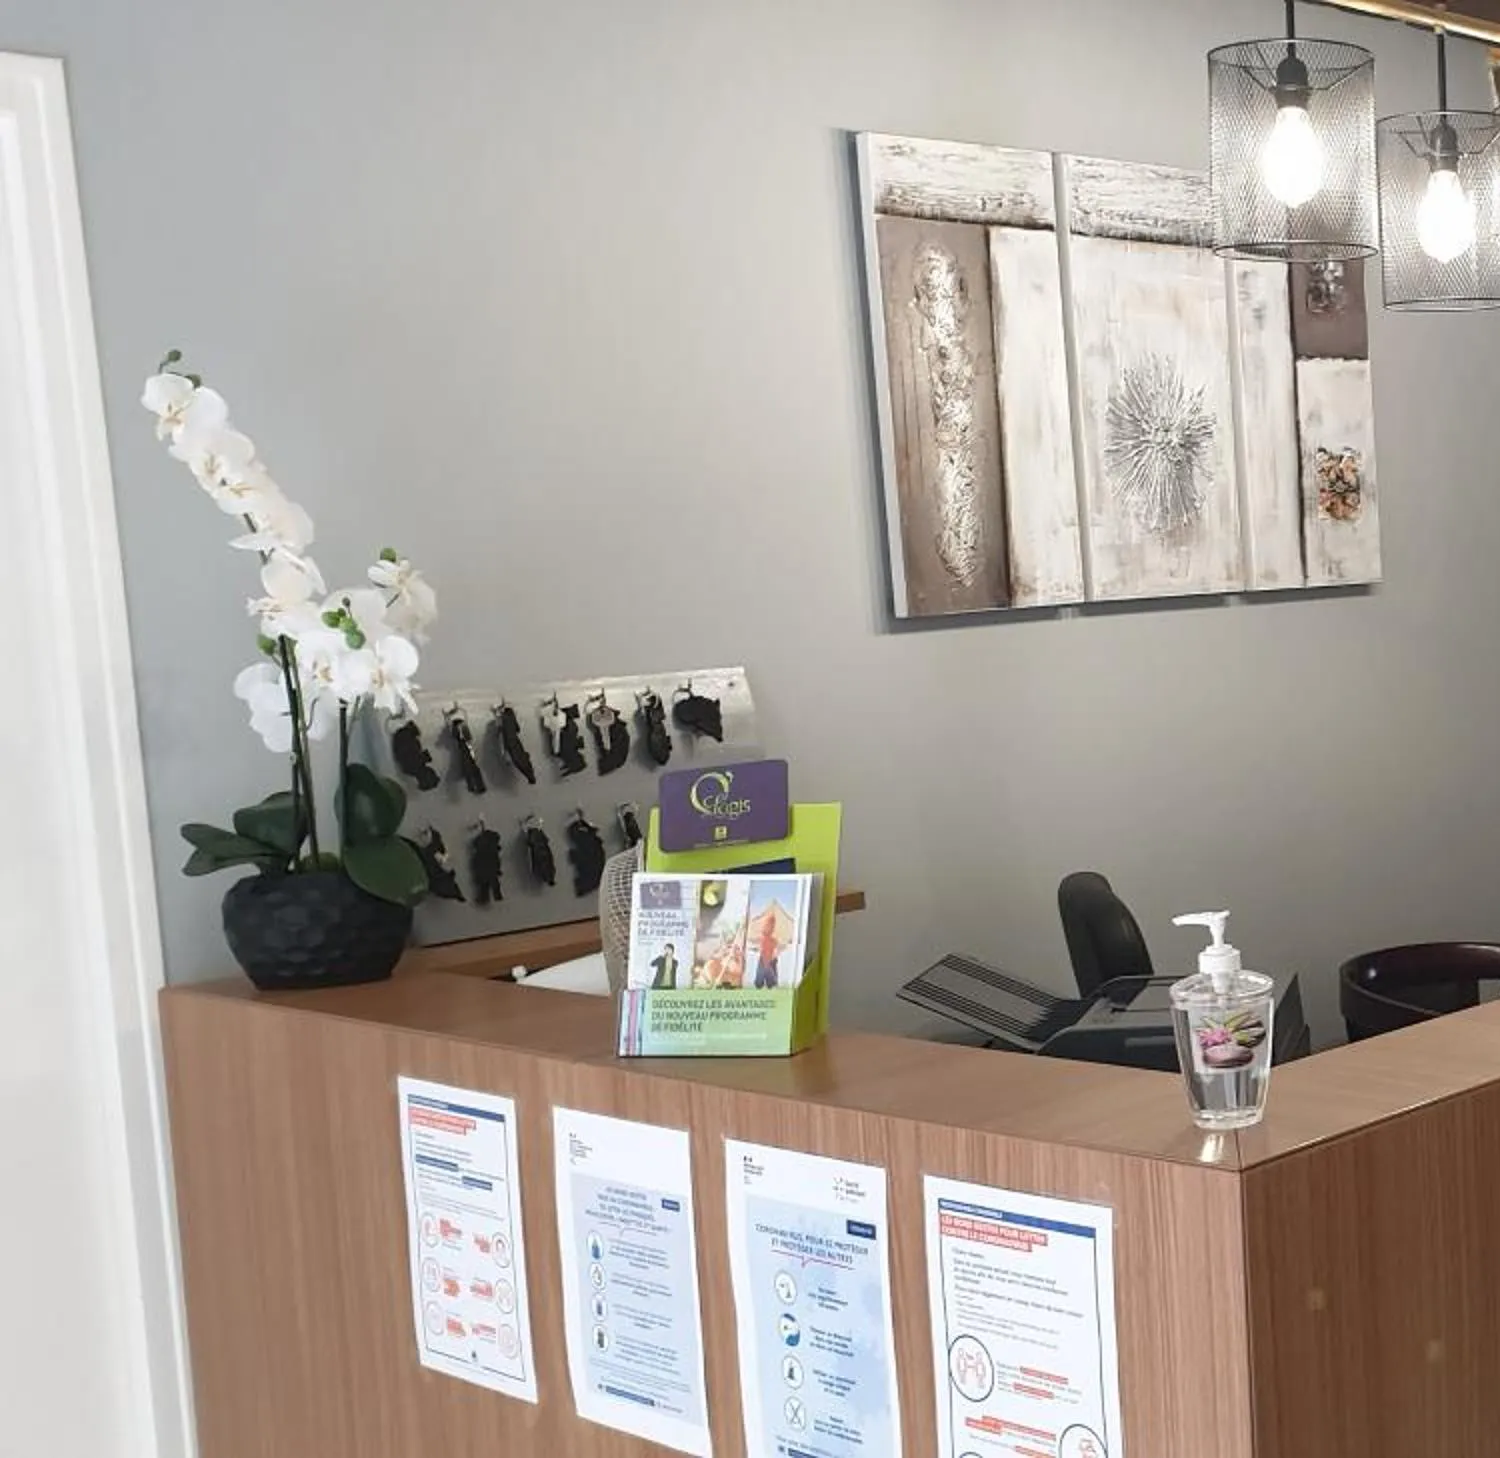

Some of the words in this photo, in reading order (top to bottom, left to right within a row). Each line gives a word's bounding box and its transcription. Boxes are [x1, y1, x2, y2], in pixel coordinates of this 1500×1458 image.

[651, 998, 705, 1010] DÉCOUVREZ
[706, 999, 723, 1010] LES
[651, 1010, 665, 1021] DU
[666, 1010, 709, 1021] NOUVEAU
[709, 1010, 768, 1021] PROGRAMME
